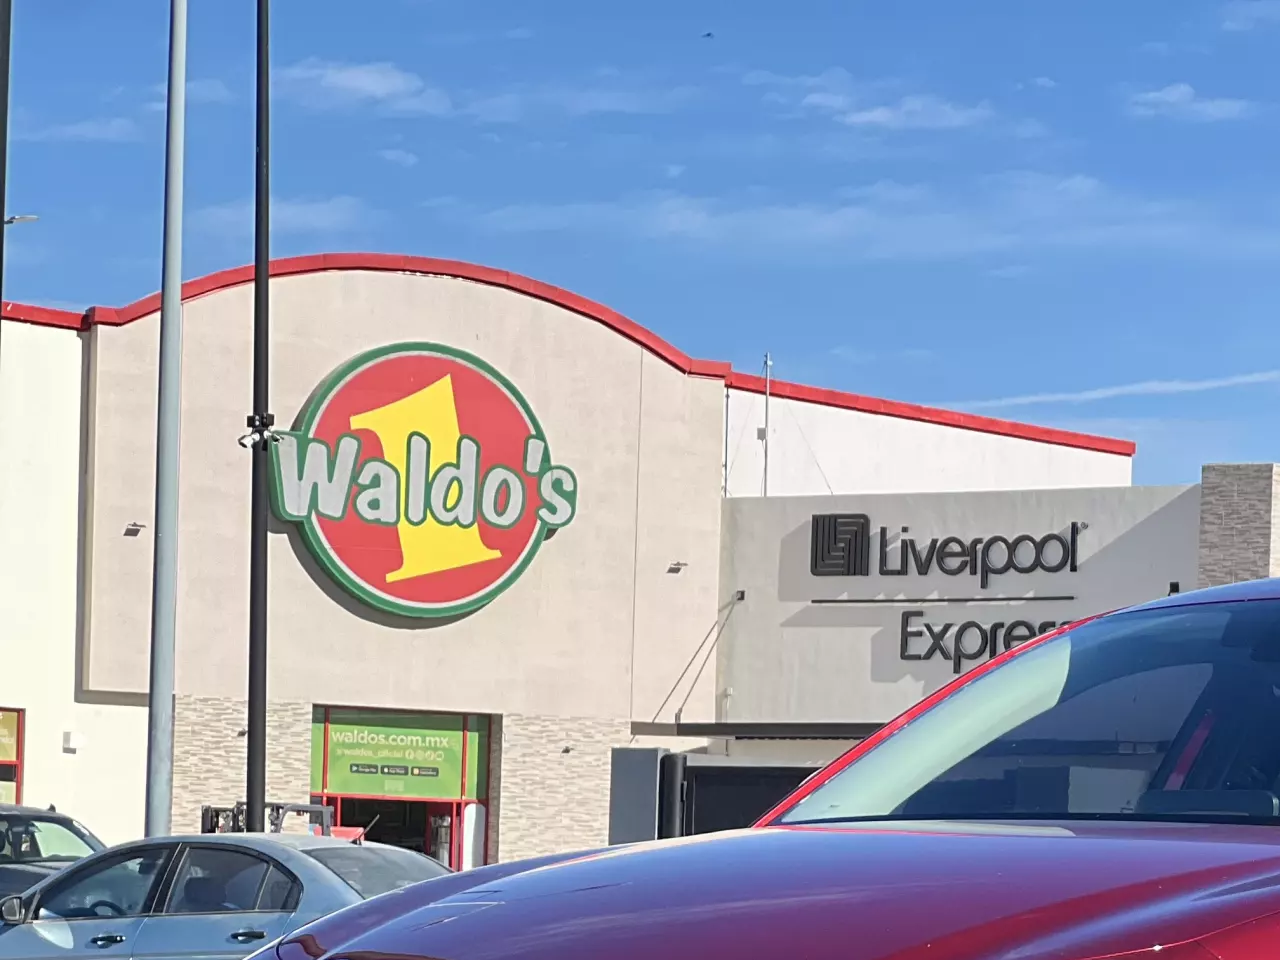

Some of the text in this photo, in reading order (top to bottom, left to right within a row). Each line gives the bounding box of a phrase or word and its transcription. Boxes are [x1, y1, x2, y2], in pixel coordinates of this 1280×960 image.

[272, 431, 577, 529] Waldo's
[879, 521, 1078, 589] Liverpool
[900, 611, 1075, 674] Expre
[331, 729, 449, 748] waldos.com.mx
